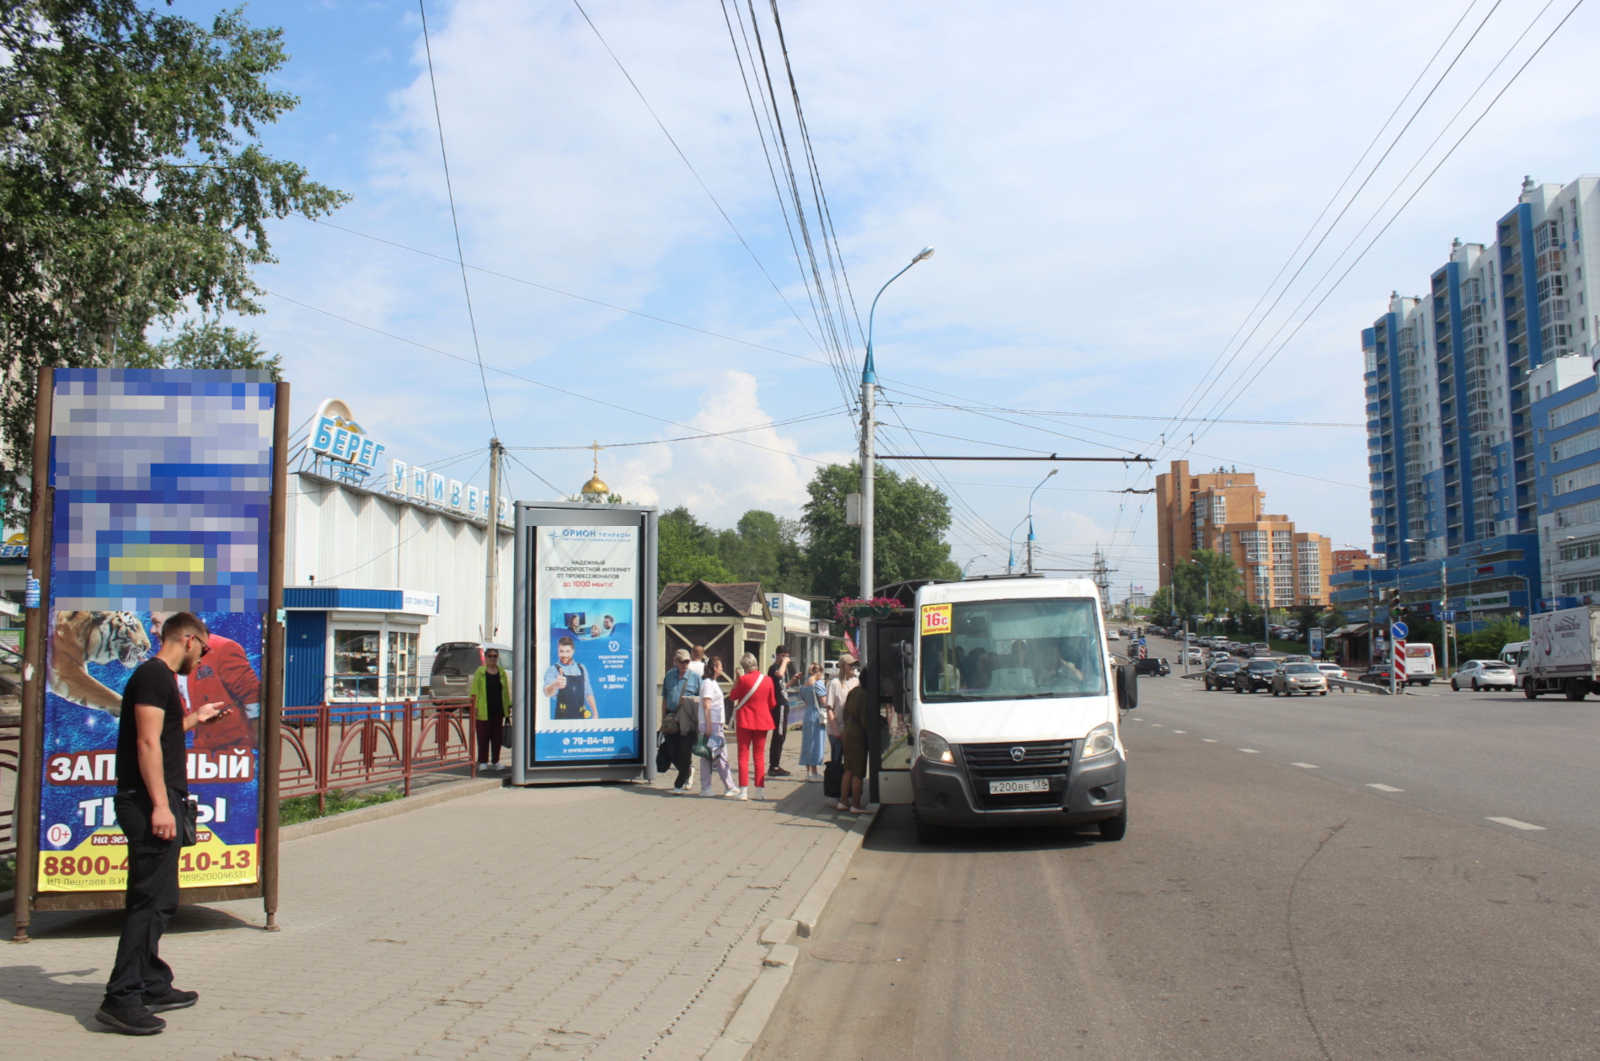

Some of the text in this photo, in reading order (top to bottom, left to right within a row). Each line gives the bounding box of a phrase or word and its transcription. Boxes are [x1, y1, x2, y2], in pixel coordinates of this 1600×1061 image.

[313, 415, 386, 468] БЕРЕГ
[562, 529, 596, 537] ОРИОН
[676, 602, 724, 613] КВАС
[572, 736, 615, 745] 79-84-89
[51, 827, 70, 841] 0+
[92, 834, 108, 844] на
[47, 877, 60, 886] ИП
[64, 877, 106, 886] Лештаев
